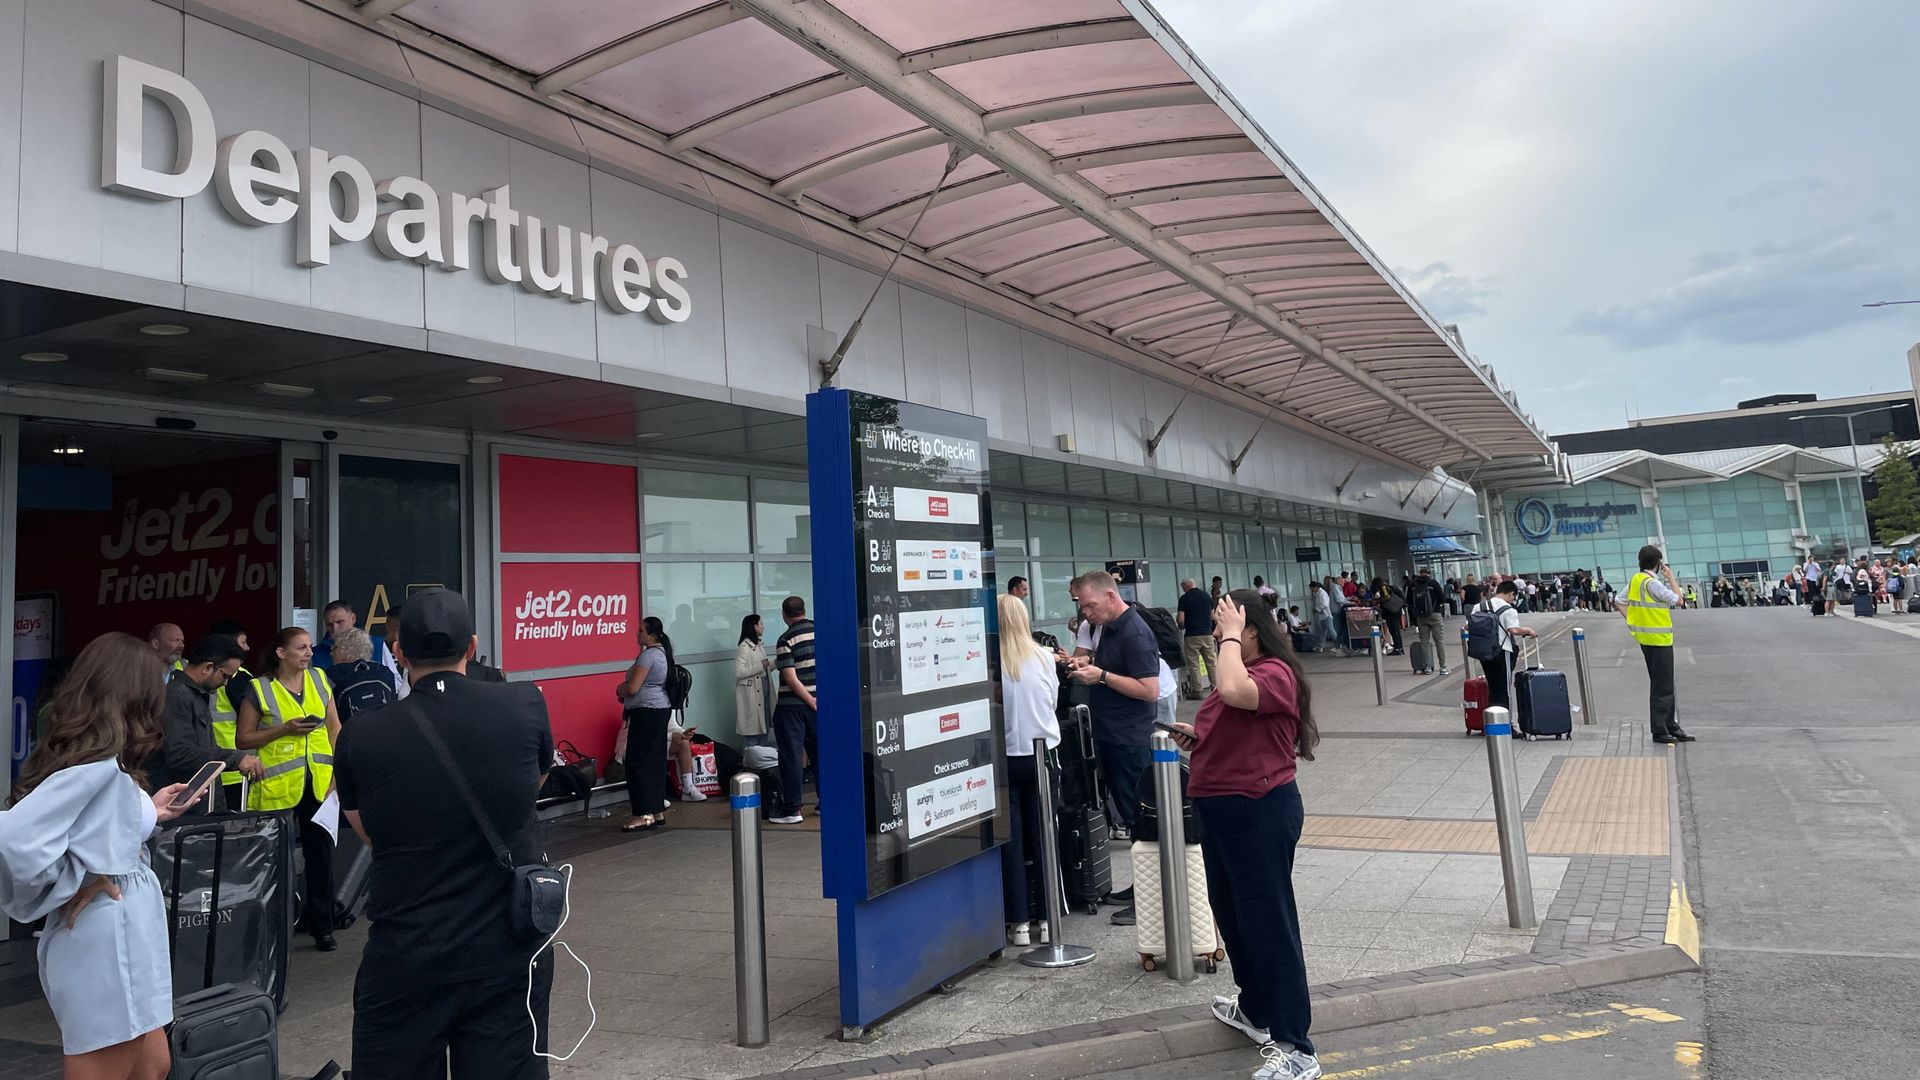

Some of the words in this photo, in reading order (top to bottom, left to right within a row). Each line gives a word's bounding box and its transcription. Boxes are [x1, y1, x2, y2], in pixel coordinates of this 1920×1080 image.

[102, 54, 692, 324] Departures
[882, 429, 921, 454] Where
[920, 437, 932, 457] to
[933, 438, 976, 462] Check-in
[867, 485, 878, 507] A
[867, 508, 891, 519] Check-in
[1553, 501, 1638, 520] Birmingham
[100, 487, 277, 561] Jet2.c
[1557, 518, 1606, 537] Airport
[870, 539, 880, 561] B
[870, 563, 893, 574] Check-in
[98, 558, 227, 606] Friendly
[515, 589, 627, 620] Jet2.com
[515, 620, 569, 641] Friendly
[571, 619, 594, 637] low
[597, 618, 627, 634] fares
[872, 614, 883, 637] C
[872, 637, 896, 649] Check-in
[876, 720, 887, 744] D
[877, 743, 900, 757] Check-in
[934, 763, 952, 775] Check
[950, 758, 970, 771] screens
[934, 807, 955, 821] SunExpress
[959, 797, 978, 812] vueling
[880, 817, 904, 833] Check-in
